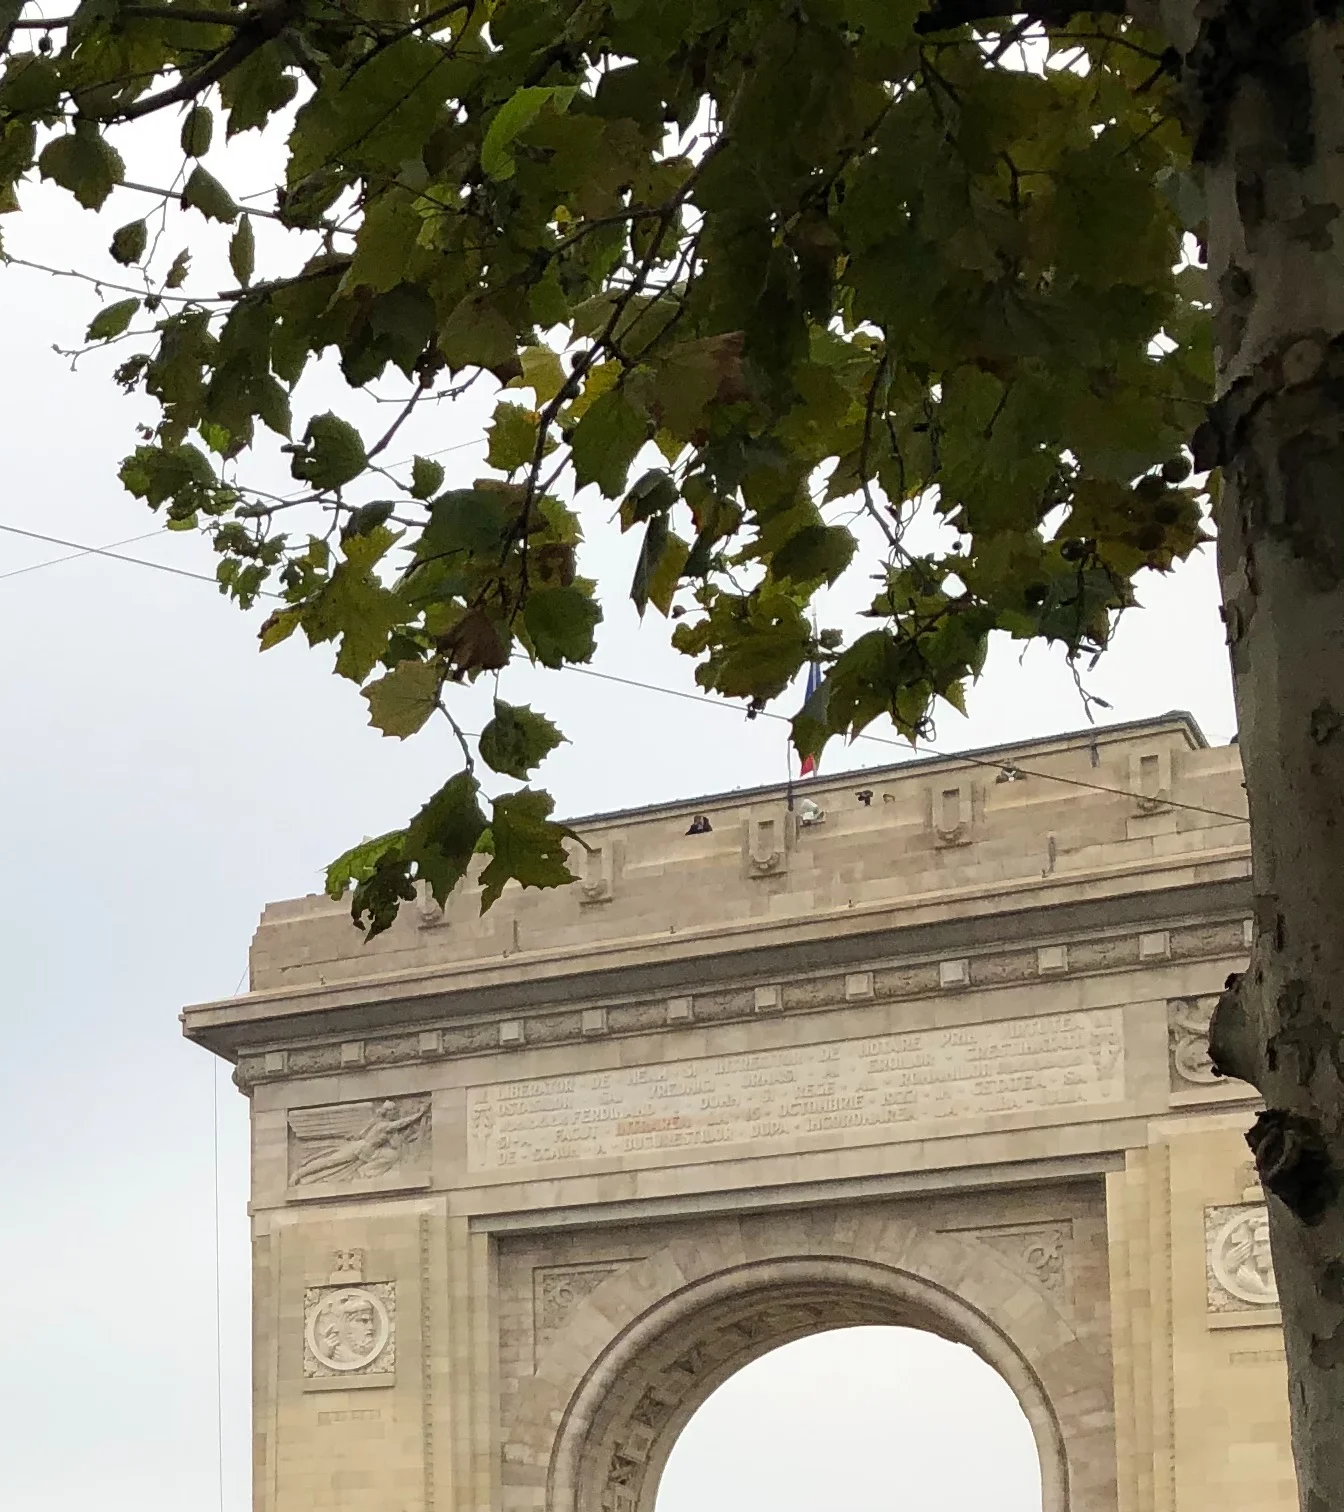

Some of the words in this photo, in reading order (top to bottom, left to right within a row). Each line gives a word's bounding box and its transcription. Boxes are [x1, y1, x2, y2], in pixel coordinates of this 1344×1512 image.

[496, 1077, 574, 1102] LIBERATOR
[591, 1072, 610, 1090] DE
[816, 1044, 841, 1063] DE
[497, 1150, 516, 1167] DE
